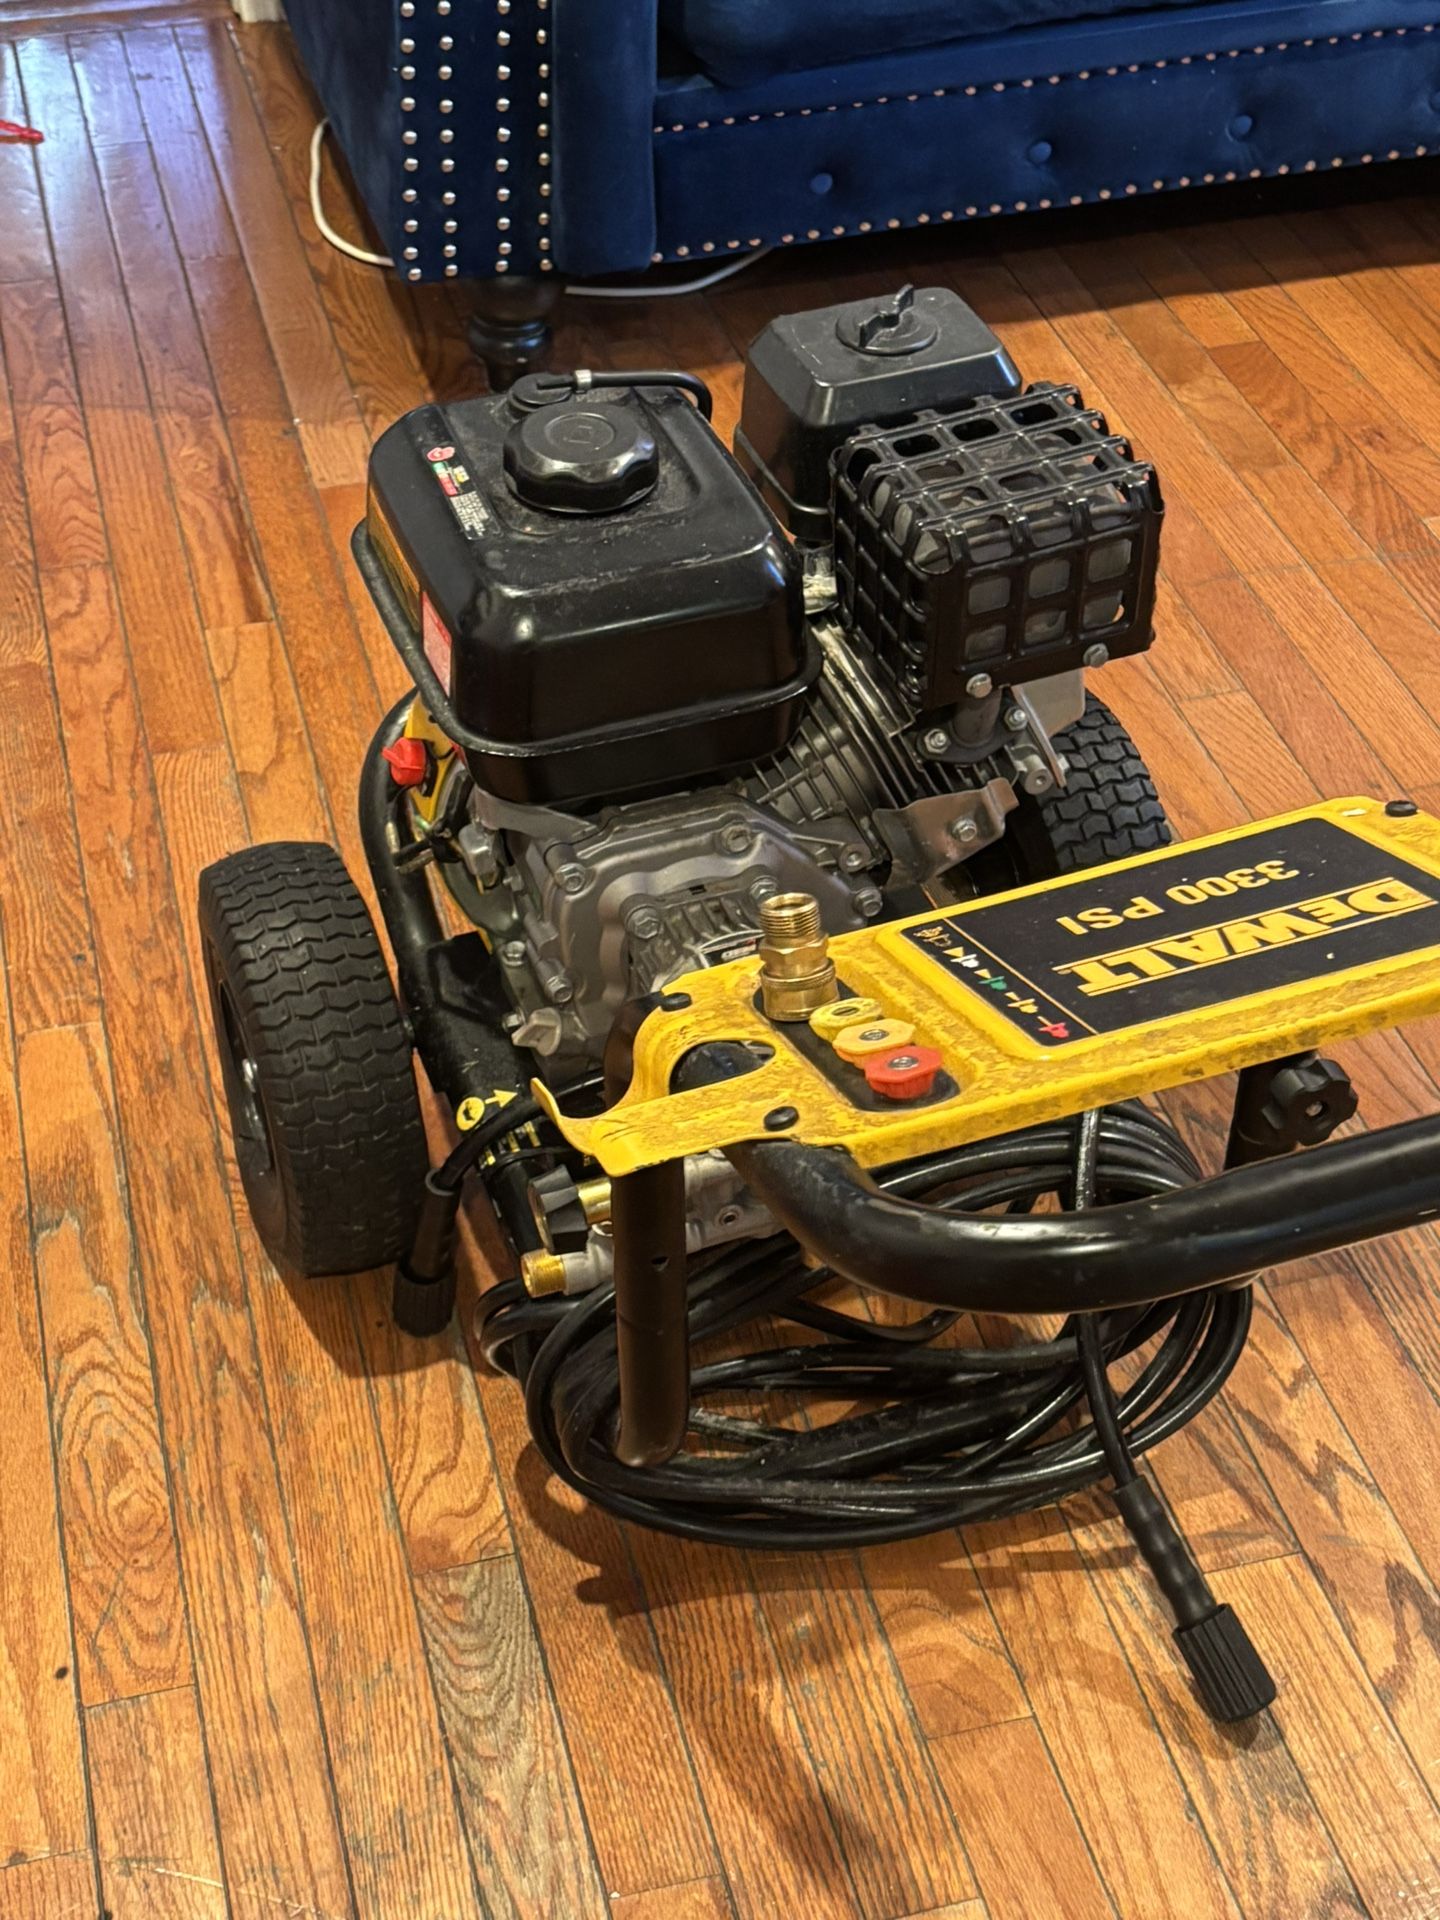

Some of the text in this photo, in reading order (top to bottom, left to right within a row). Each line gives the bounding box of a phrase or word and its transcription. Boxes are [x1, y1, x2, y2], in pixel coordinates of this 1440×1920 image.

[1056, 860, 1299, 935] 3300 PSI
[1068, 878, 1434, 995] DEWALT
